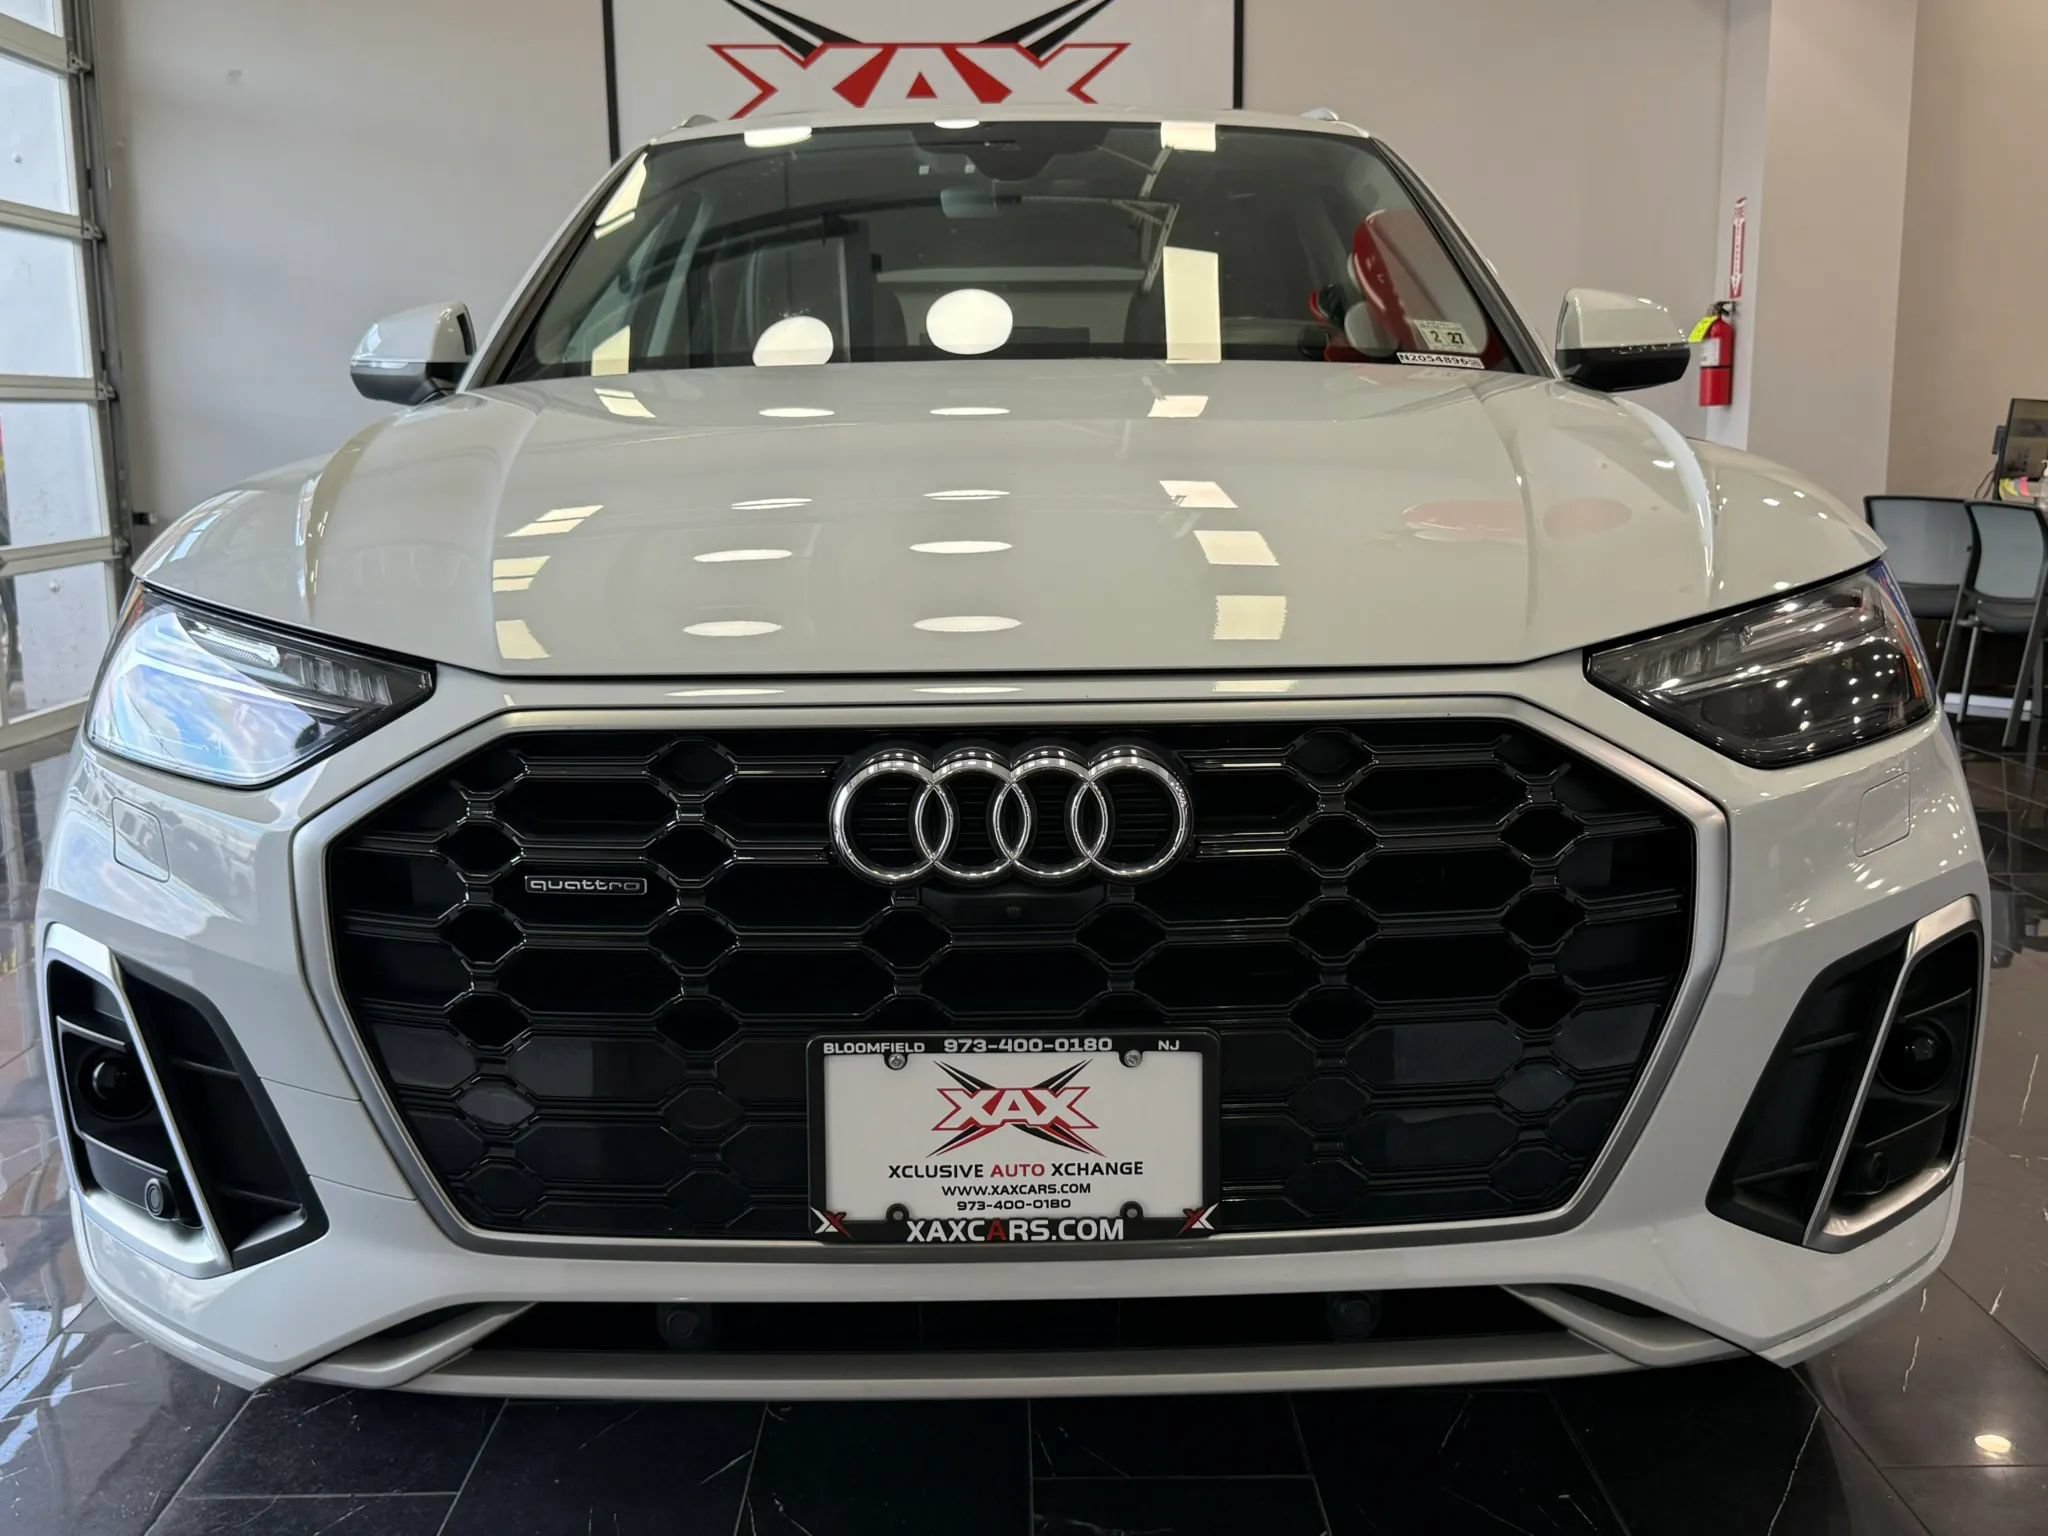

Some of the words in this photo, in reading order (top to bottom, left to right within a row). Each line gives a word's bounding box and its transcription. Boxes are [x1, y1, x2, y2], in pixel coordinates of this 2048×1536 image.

[707, 42, 1132, 120] XAX
[1430, 330, 1442, 343] 2
[1447, 331, 1464, 345] 27
[530, 879, 640, 891] quattro
[823, 1042, 925, 1054] BLOOMFIELD
[944, 1037, 1112, 1053] 973-400-0180
[1158, 1039, 1180, 1051] NJ
[888, 1164, 984, 1179] XCLUSIVE
[990, 1163, 1045, 1178] AUTO
[1051, 1161, 1144, 1177] XCHANGE
[942, 1183, 1091, 1197] WWW.XAXCARS.COM
[957, 1199, 1071, 1211] 973-400-0180
[906, 1218, 1124, 1242] XAXCARS.COM
